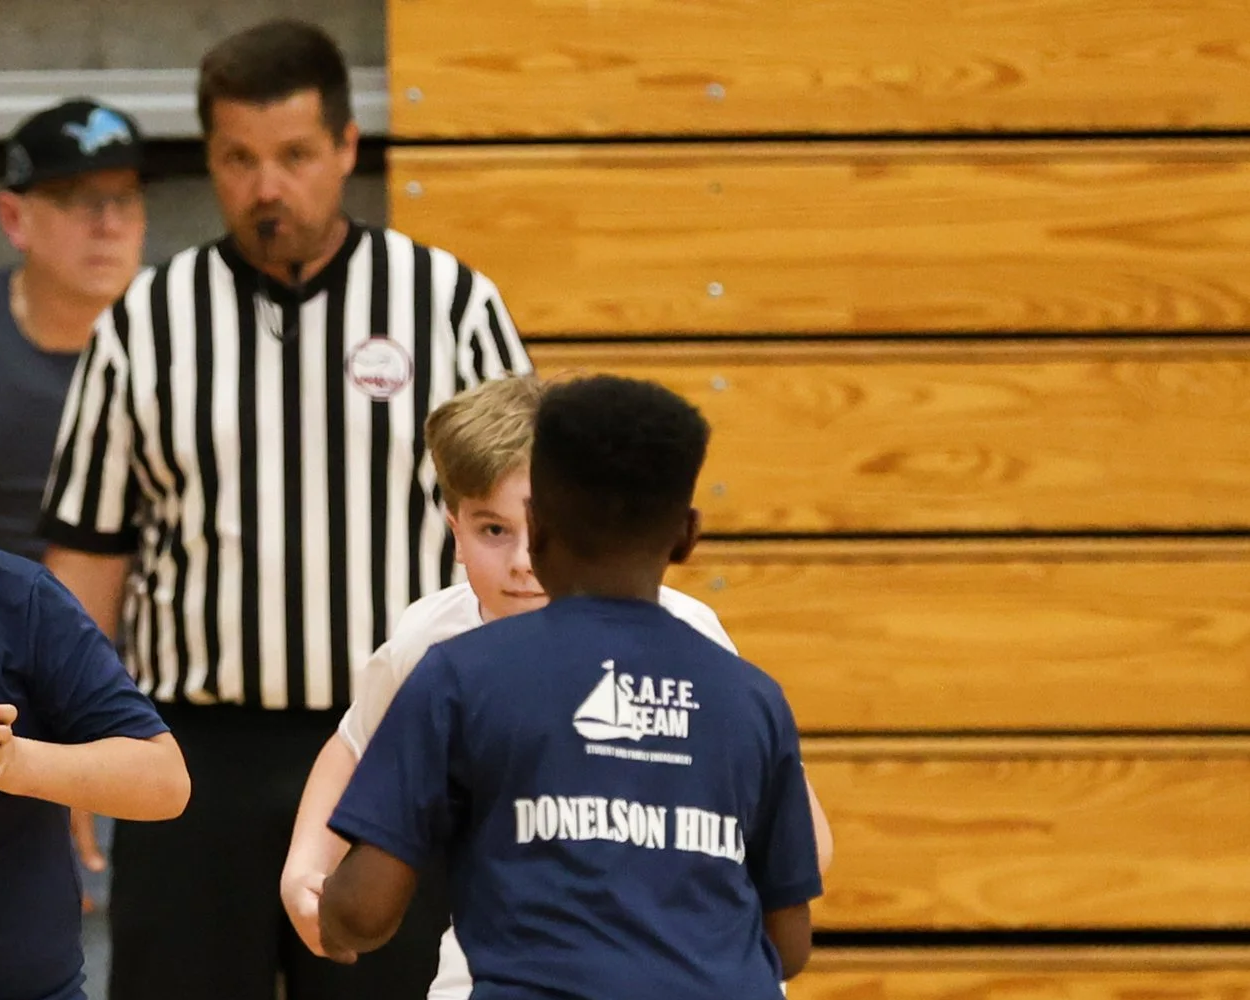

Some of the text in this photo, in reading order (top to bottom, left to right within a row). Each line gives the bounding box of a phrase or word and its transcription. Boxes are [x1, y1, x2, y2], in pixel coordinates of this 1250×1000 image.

[618, 673, 700, 709] S.A.F.E.
[631, 706, 688, 738] TEAM
[514, 796, 667, 849] DONELSON
